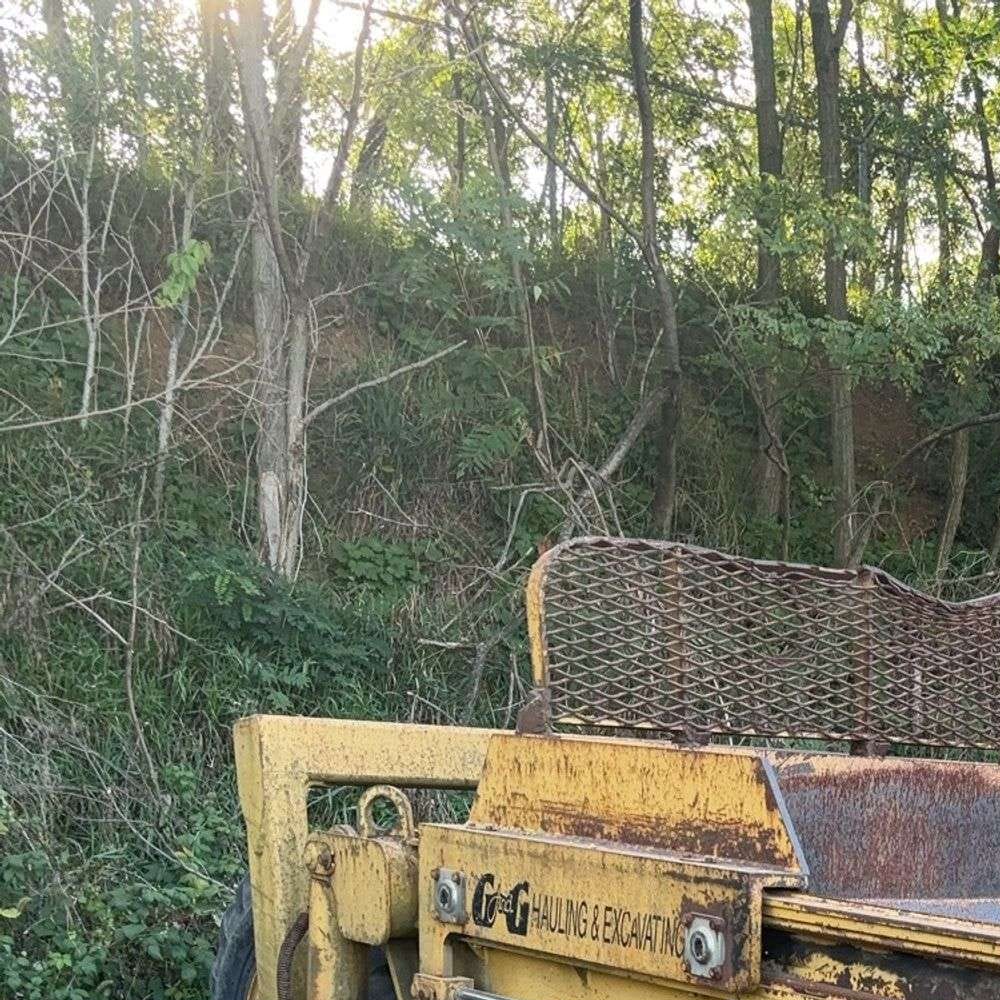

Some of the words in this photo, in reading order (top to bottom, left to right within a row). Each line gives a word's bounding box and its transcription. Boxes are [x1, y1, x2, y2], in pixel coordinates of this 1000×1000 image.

[531, 894, 588, 938] HAULING
[590, 904, 600, 941] &
[603, 906, 685, 958] EXCAVATING
